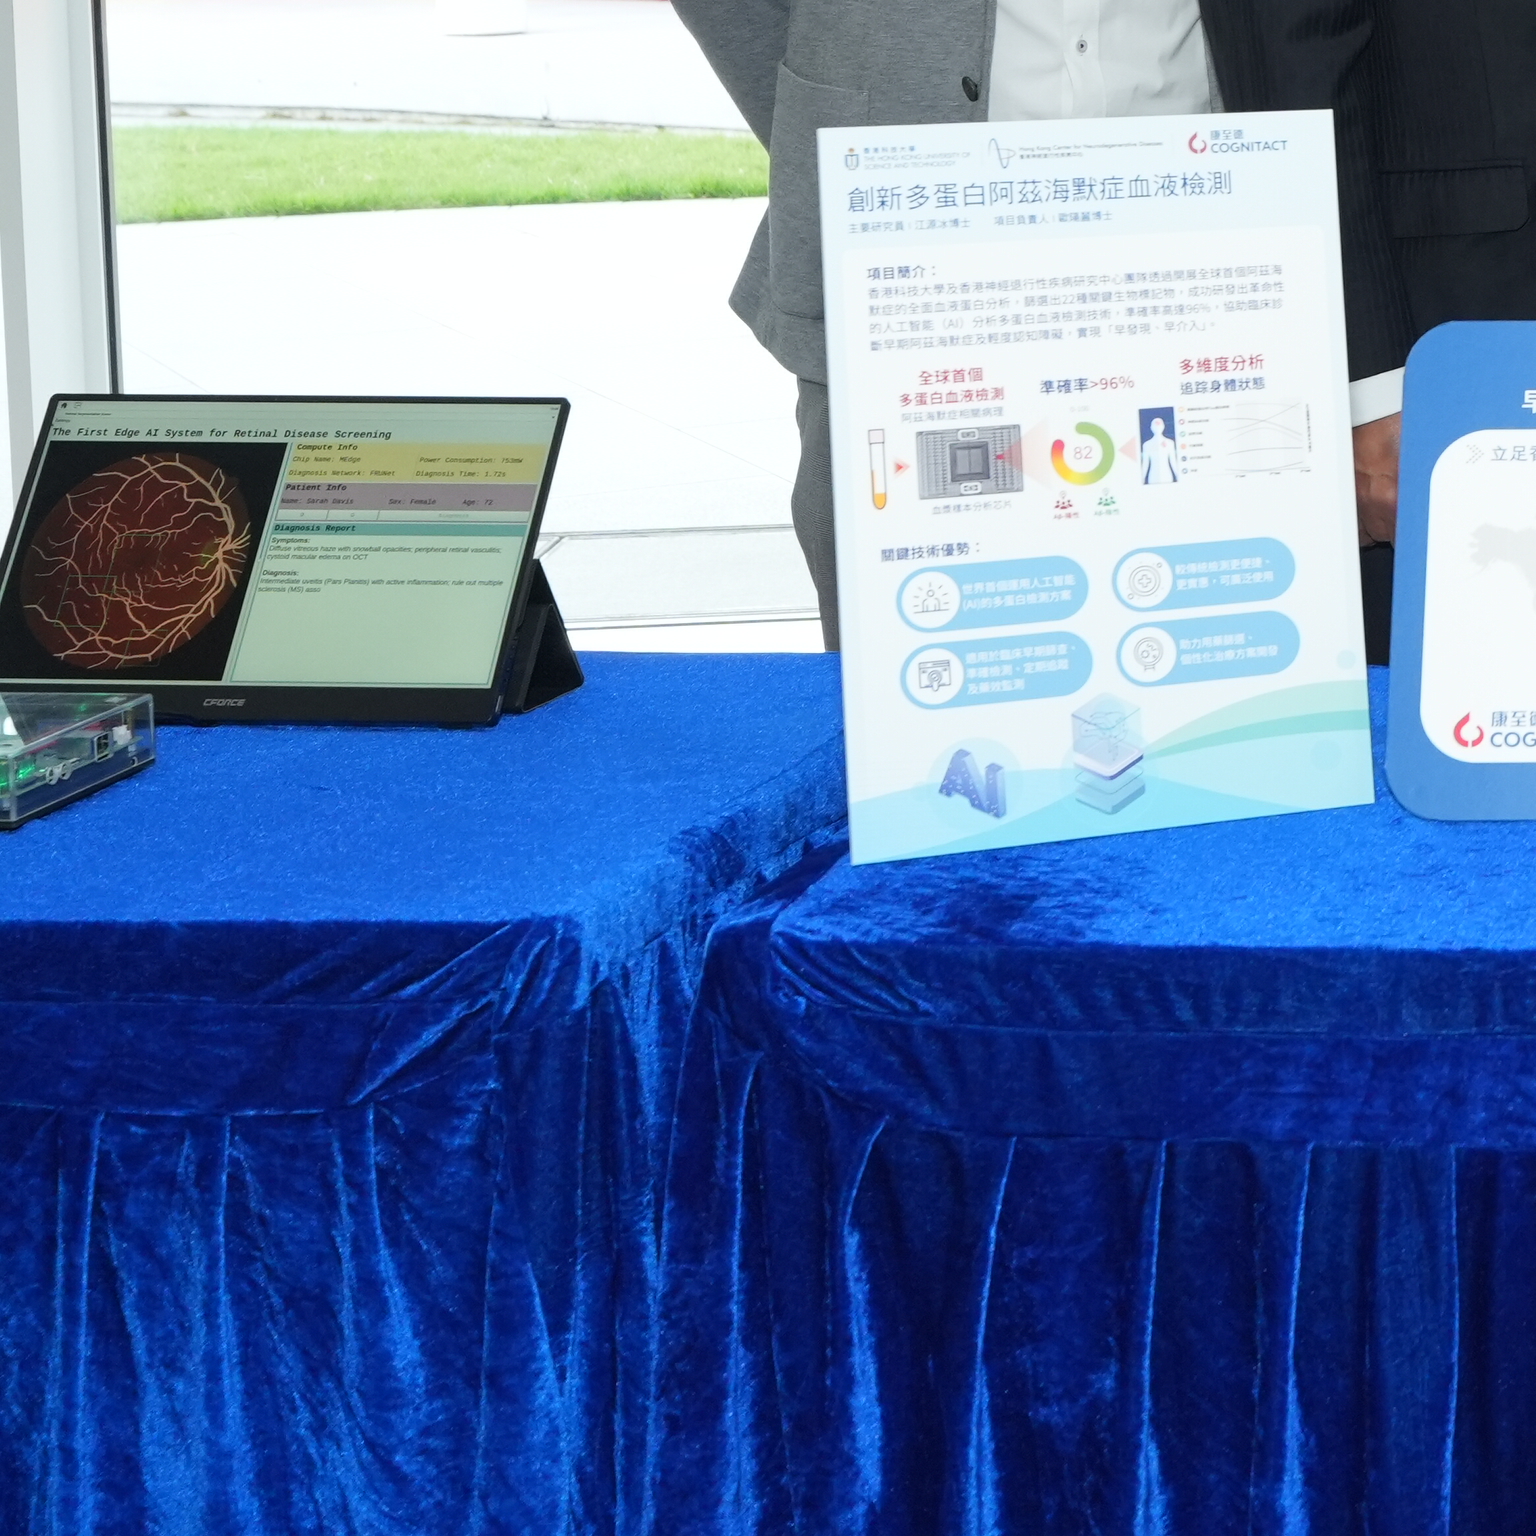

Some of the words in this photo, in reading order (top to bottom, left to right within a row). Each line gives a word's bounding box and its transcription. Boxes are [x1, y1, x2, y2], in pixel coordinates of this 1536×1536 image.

[1211, 140, 1288, 154] COGNITACT
[847, 169, 1233, 214] 創新多蛋白阿茲海默症血液檢測
[1179, 354, 1265, 376] 多維度分析
[918, 367, 984, 386] 全球首個
[899, 386, 1005, 407] 多蛋白血液檢測
[52, 427, 71, 437] The
[77, 427, 108, 437] First
[114, 428, 140, 438] Edge
[146, 428, 159, 437] AI
[164, 428, 203, 439] System
[209, 428, 228, 438] for
[233, 429, 278, 438] Retinal
[284, 429, 329, 439] Disease
[334, 430, 392, 441] Screening
[296, 443, 333, 453] Compute
[337, 443, 358, 452] Info
[1073, 446, 1093, 460] 82
[292, 456, 312, 464] Chip
[419, 456, 442, 464] Power
[445, 457, 497, 465] Consumption:
[288, 469, 329, 478] Diagnosis
[415, 470, 456, 478] Diagnosis
[285, 483, 321, 491] Patient
[325, 483, 347, 491] Info
[281, 497, 302, 505] Name:
[306, 497, 329, 505] Sarah
[331, 497, 354, 505] Davis
[462, 498, 479, 507] Age:
[274, 524, 321, 533] Diagnosis
[325, 524, 357, 534] Report
[271, 536, 310, 545] Symptoms:
[262, 569, 299, 578] Diagnosis:
